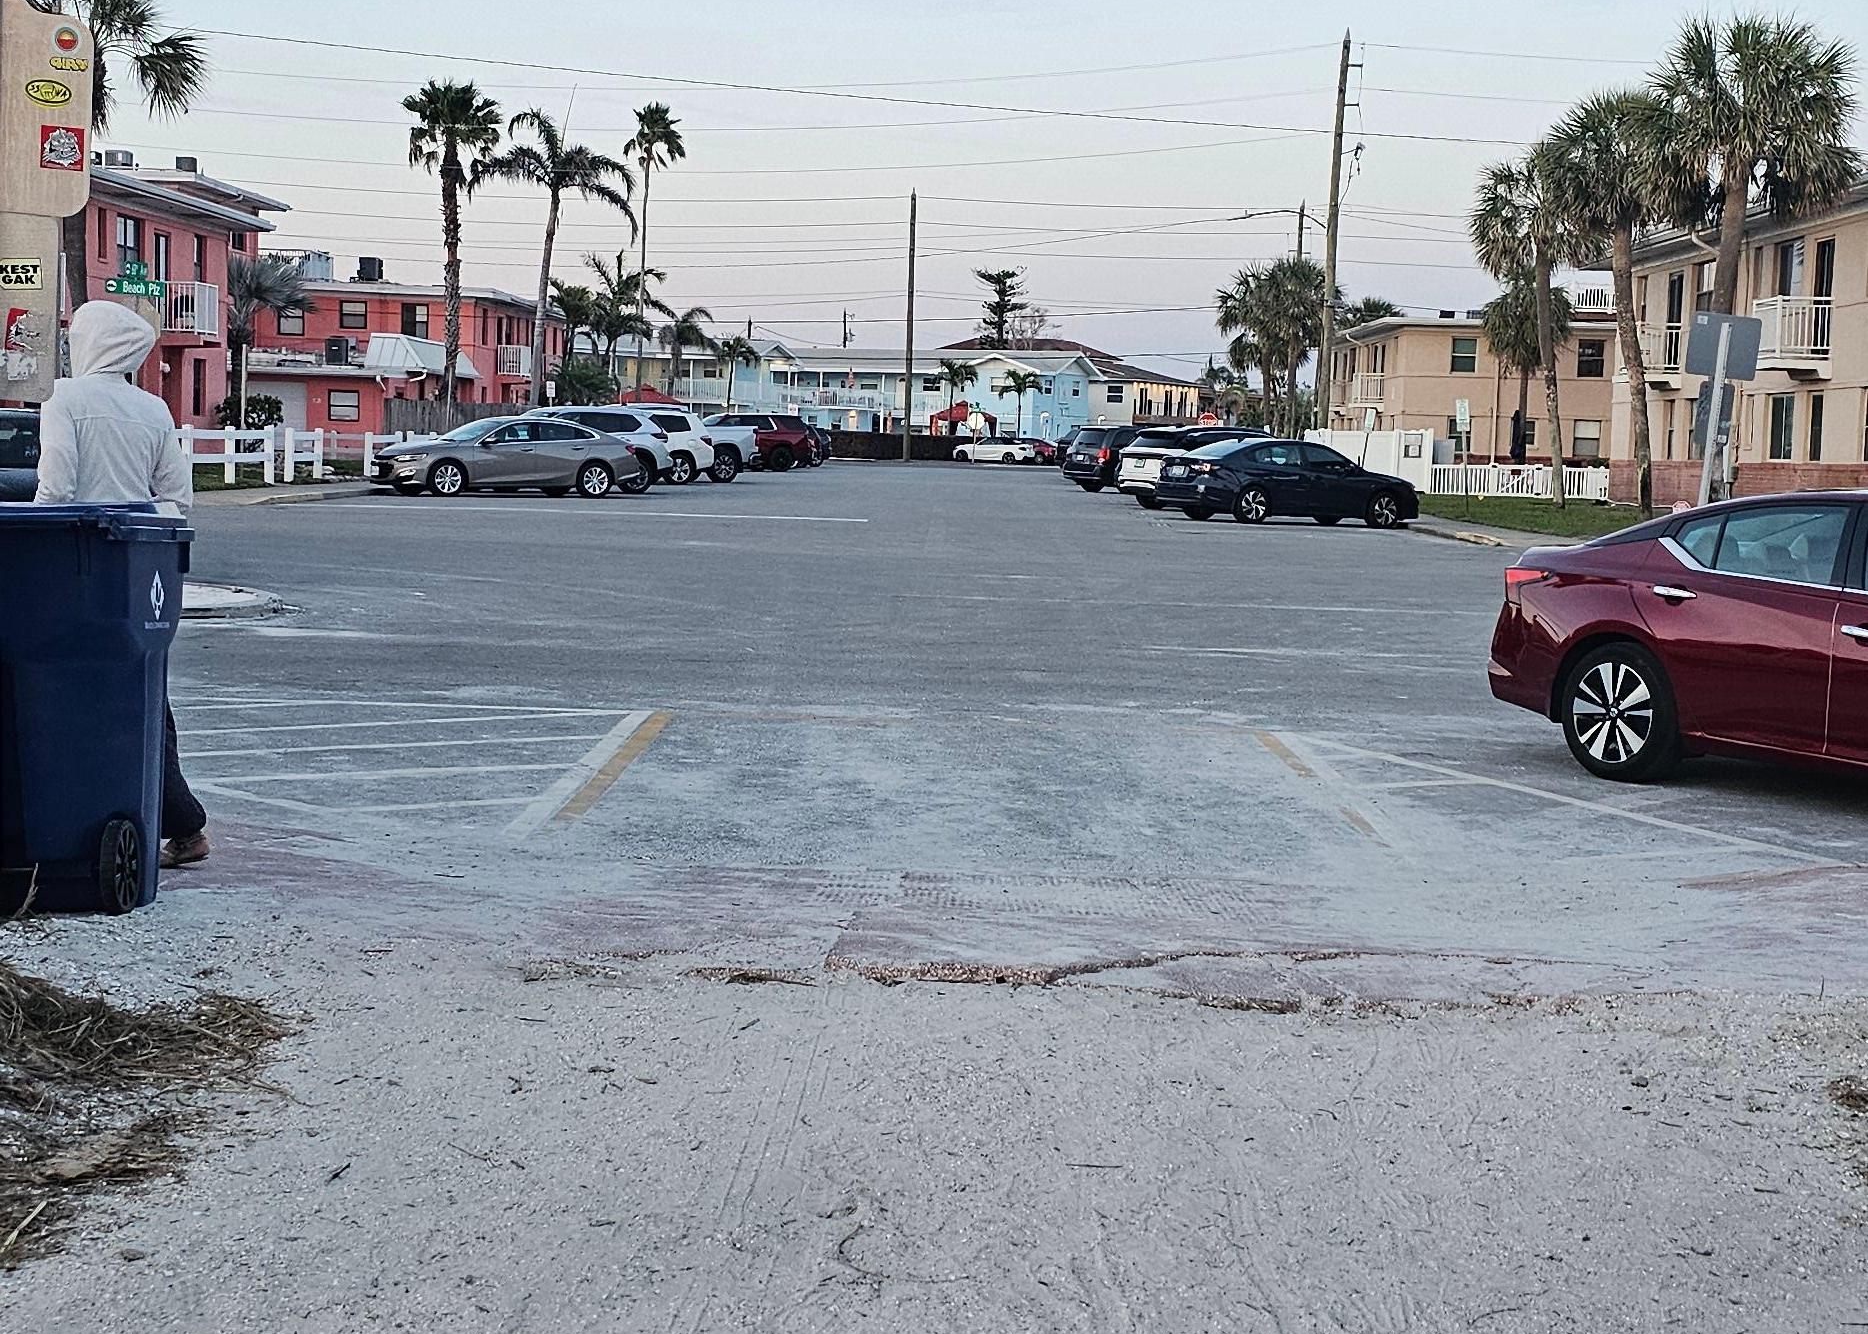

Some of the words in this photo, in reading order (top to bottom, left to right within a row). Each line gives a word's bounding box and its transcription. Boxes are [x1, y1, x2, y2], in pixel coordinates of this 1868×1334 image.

[2, 275, 35, 284] GAK
[122, 280, 146, 294] Beach
[148, 282, 161, 296] Plz
